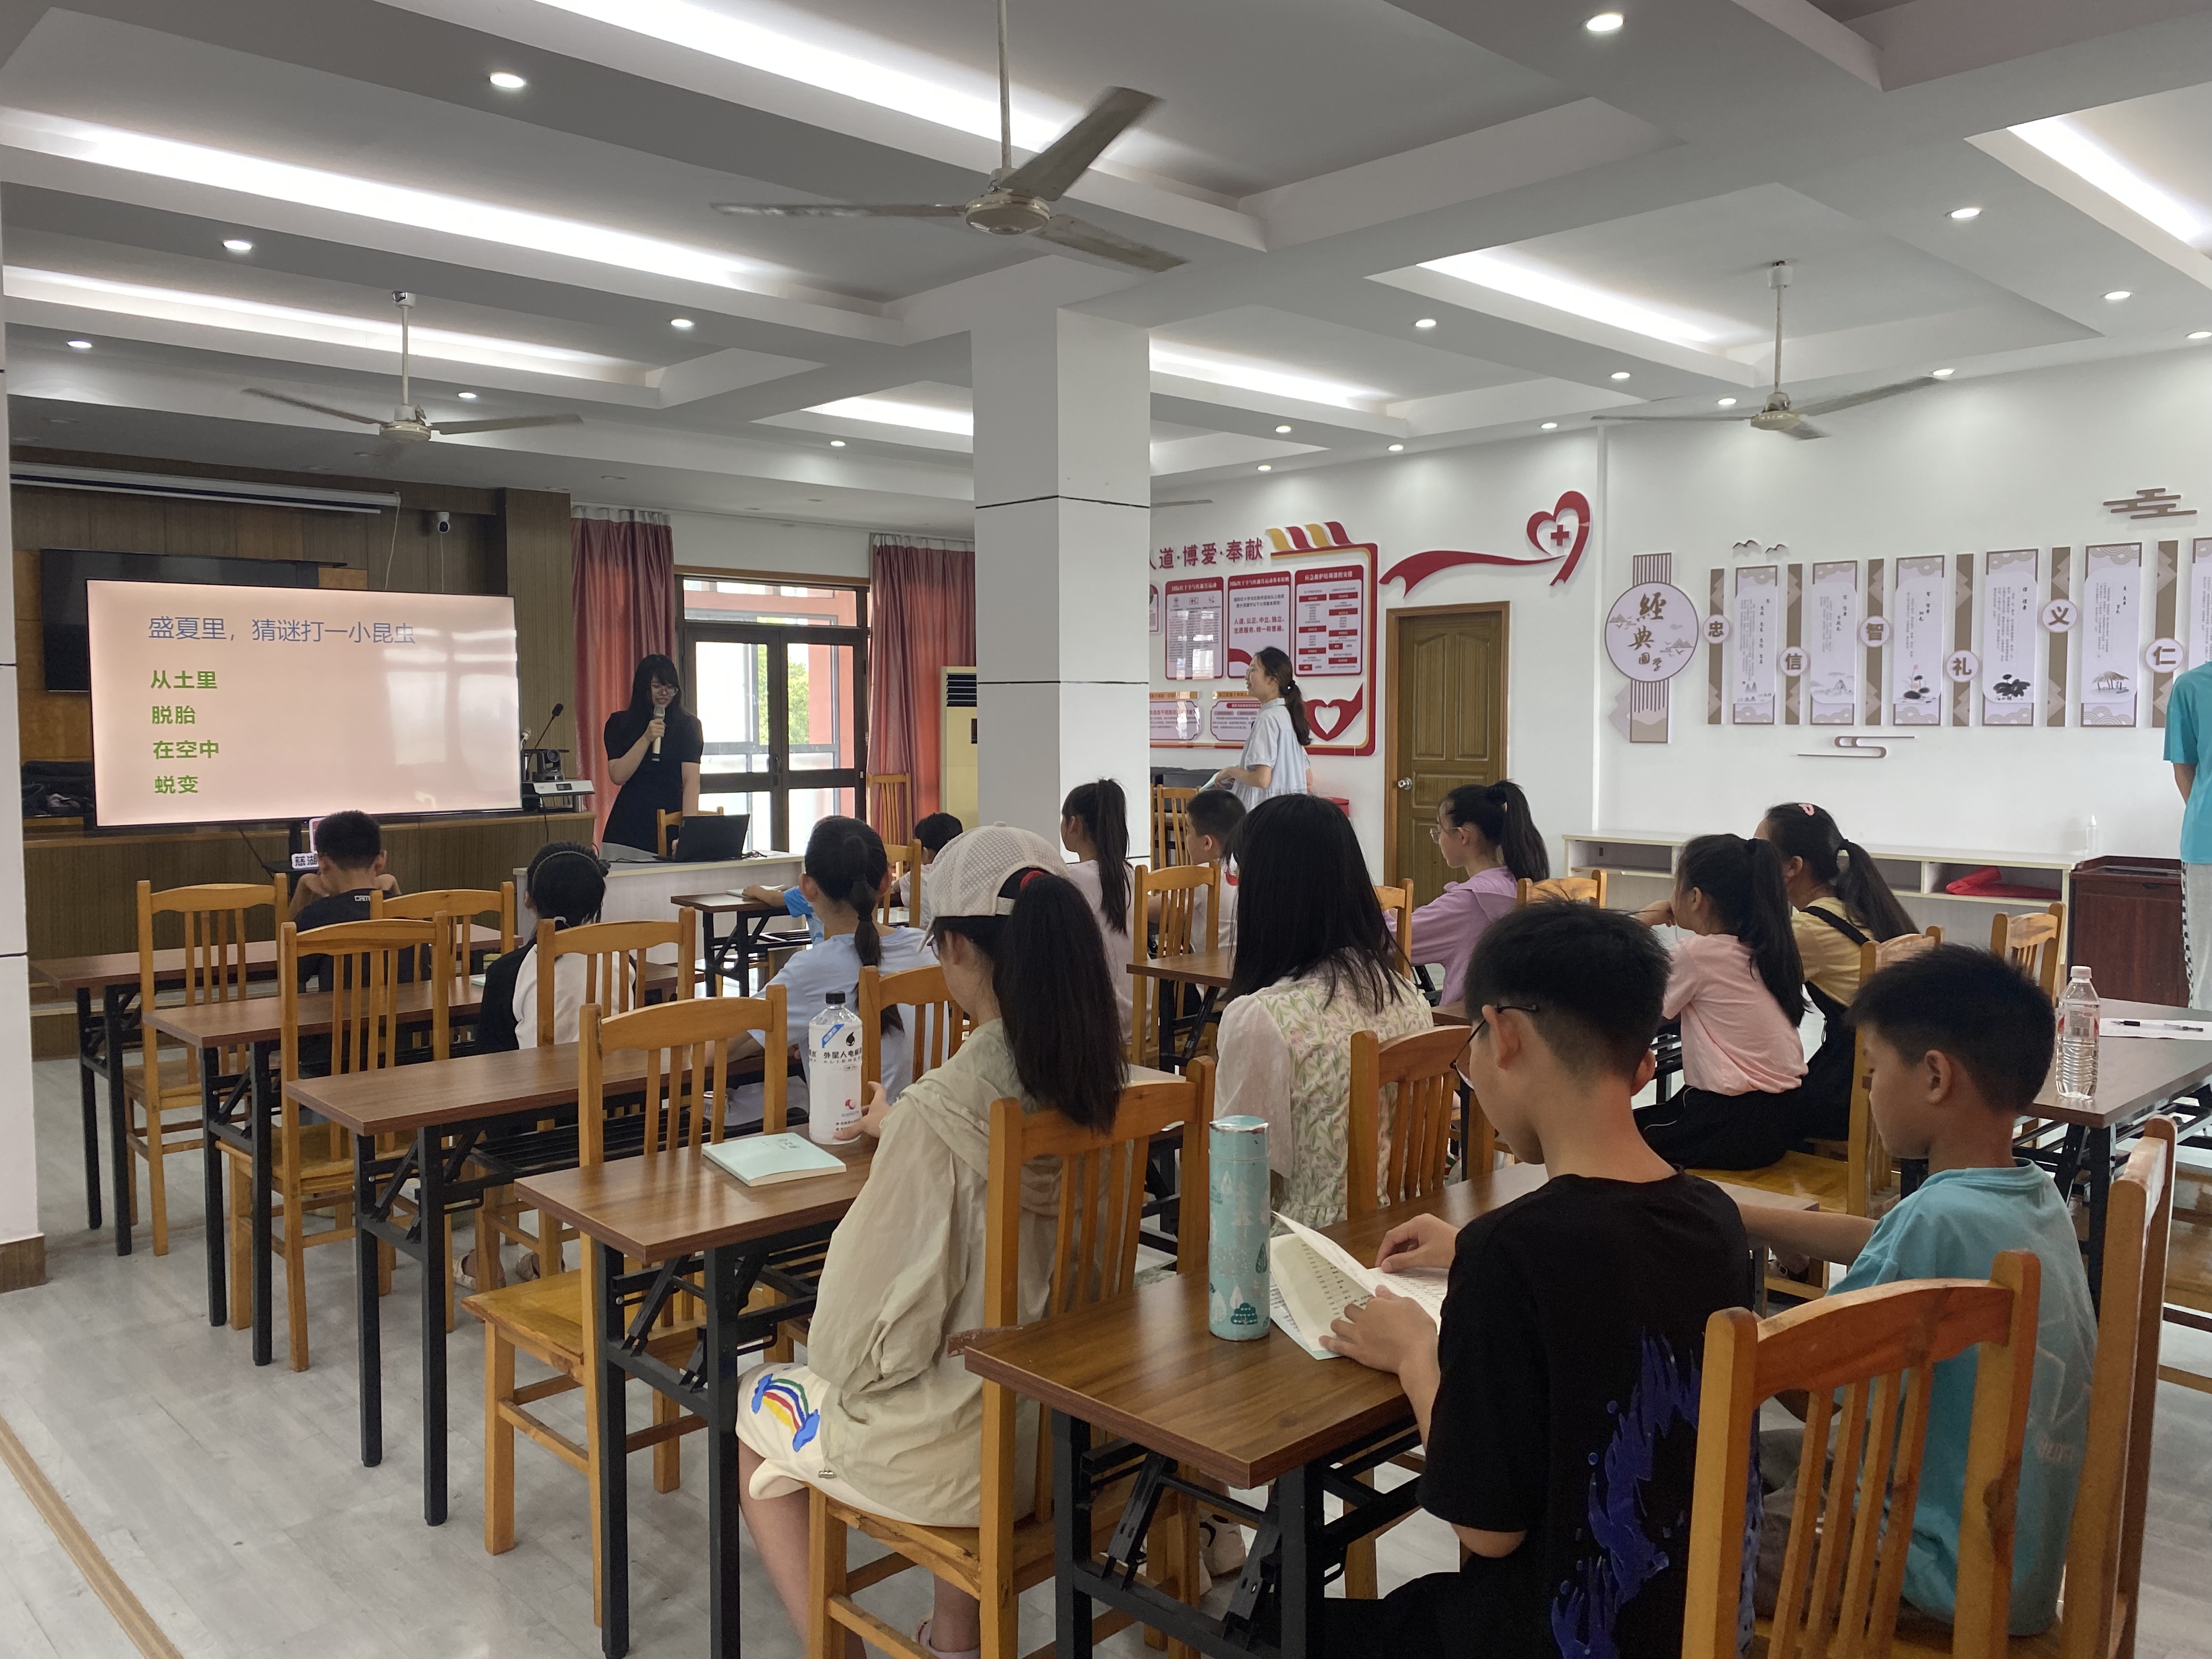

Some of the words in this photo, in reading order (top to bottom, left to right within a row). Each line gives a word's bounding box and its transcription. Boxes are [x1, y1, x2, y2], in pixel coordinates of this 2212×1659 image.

[2049, 606, 2069, 625] 义
[148, 616, 416, 645] 盛夏里，猜谜打一小昆虫
[1708, 621, 1724, 637] 忠
[1866, 623, 1884, 641] 智
[1785, 653, 1803, 670] 信
[2153, 645, 2176, 665] 仁
[1952, 657, 1972, 676] 礼
[150, 669, 217, 690] 从土里
[151, 706, 196, 725] 脱胎
[153, 740, 219, 760] 在空中
[154, 775, 199, 794] 蜕变
